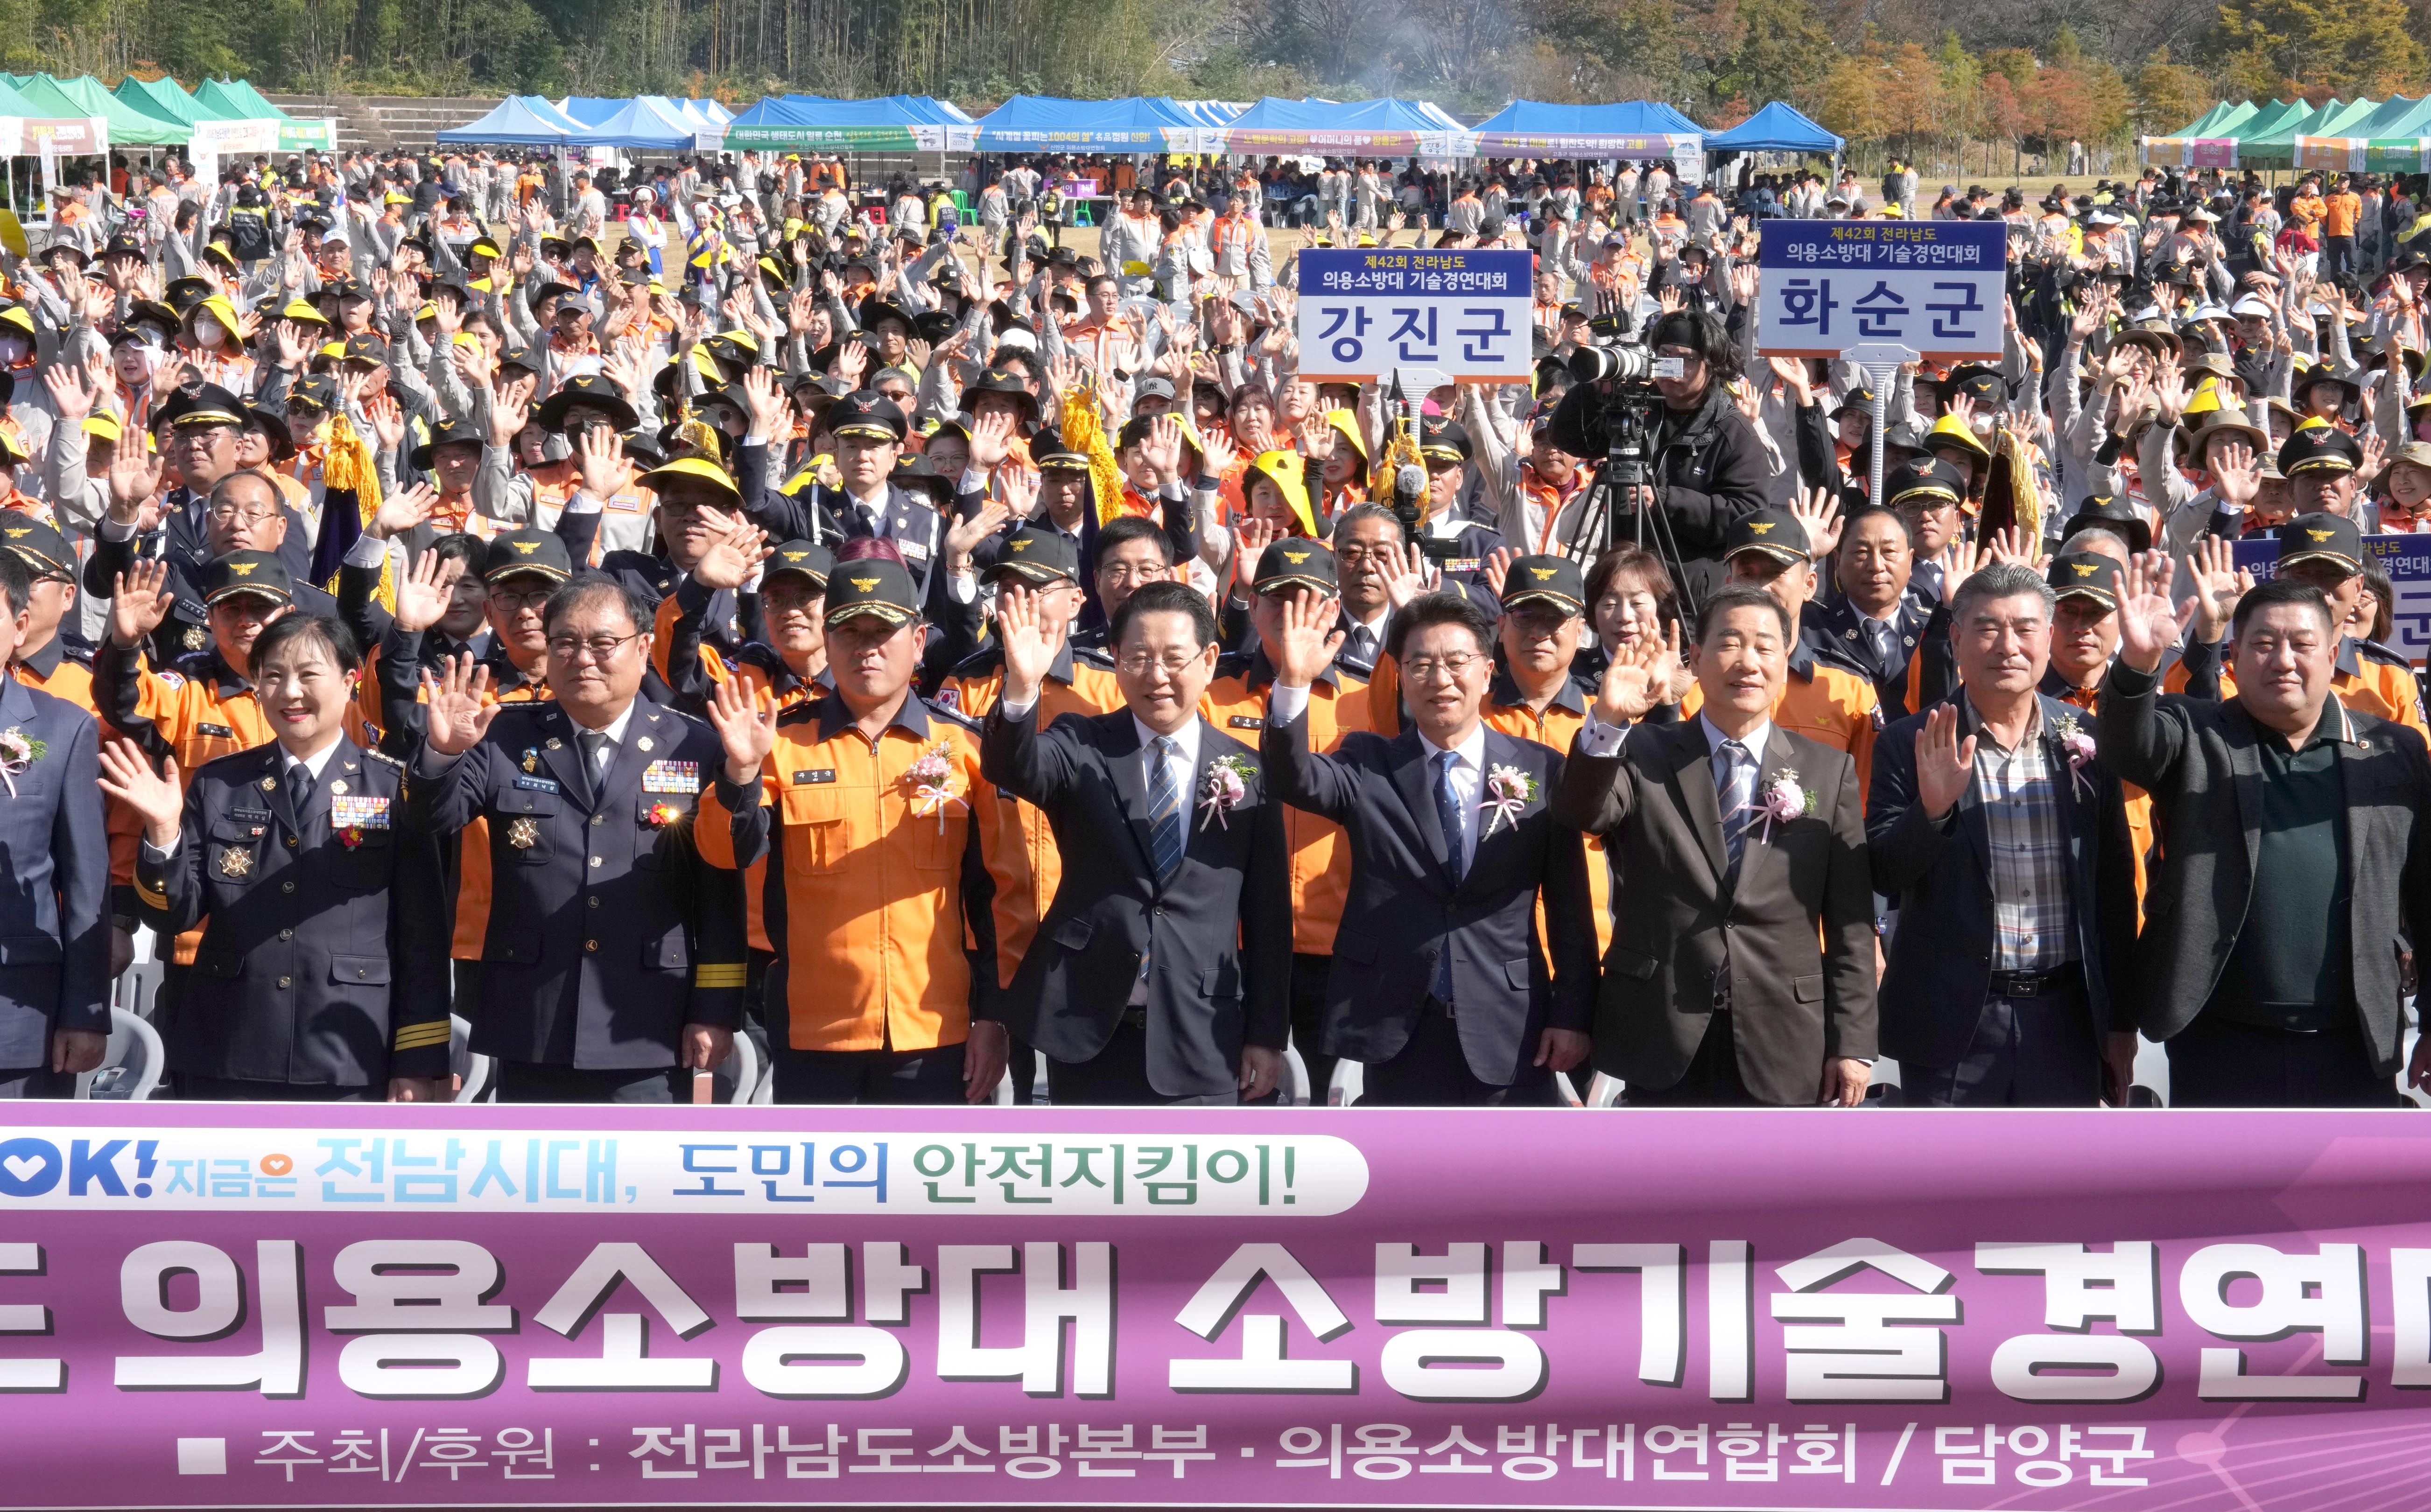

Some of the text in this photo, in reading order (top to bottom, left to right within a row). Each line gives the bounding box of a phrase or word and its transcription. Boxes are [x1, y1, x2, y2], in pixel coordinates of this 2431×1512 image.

[736, 130, 769, 140] 대한민국
[771, 131, 804, 141] 생태도시
[807, 131, 822, 141] 일류
[1131, 132, 1150, 142] 신안!
[1244, 134, 1286, 144] 노벨문학의
[1288, 134, 1307, 145] 고장!
[1318, 135, 1351, 145] 어머니의
[1373, 135, 1401, 146] 장흥군!
[1502, 138, 1528, 147] 우주로
[1529, 138, 1558, 148] 미래로!
[1599, 139, 1625, 149] 희망찬
[1626, 139, 1647, 149] 고흥!
[1830, 226, 1937, 241] 제42회 전라남도
[1364, 255, 1466, 269] 제42회 전라남도
[1786, 243, 1980, 264] 의용소방대 기술경연대회
[1323, 271, 1507, 291] 의용소방대 기술경연대회
[1779, 279, 1983, 338] 화순군
[1318, 306, 1511, 362] 강진군
[2361, 541, 2401, 555] 라남도
[0, 1137, 1296, 1206] OK! 지금은 전남시대, 도민의 안전지킴이!
[114, 1239, 1117, 1400] 의용소방대
[253, 1427, 556, 1484] 주최/후원
[628, 1423, 1216, 1480] 전라남도소방본부
[1275, 1423, 1857, 1486] 의용소방대연합회
[1933, 1425, 2155, 1487] 담양군
